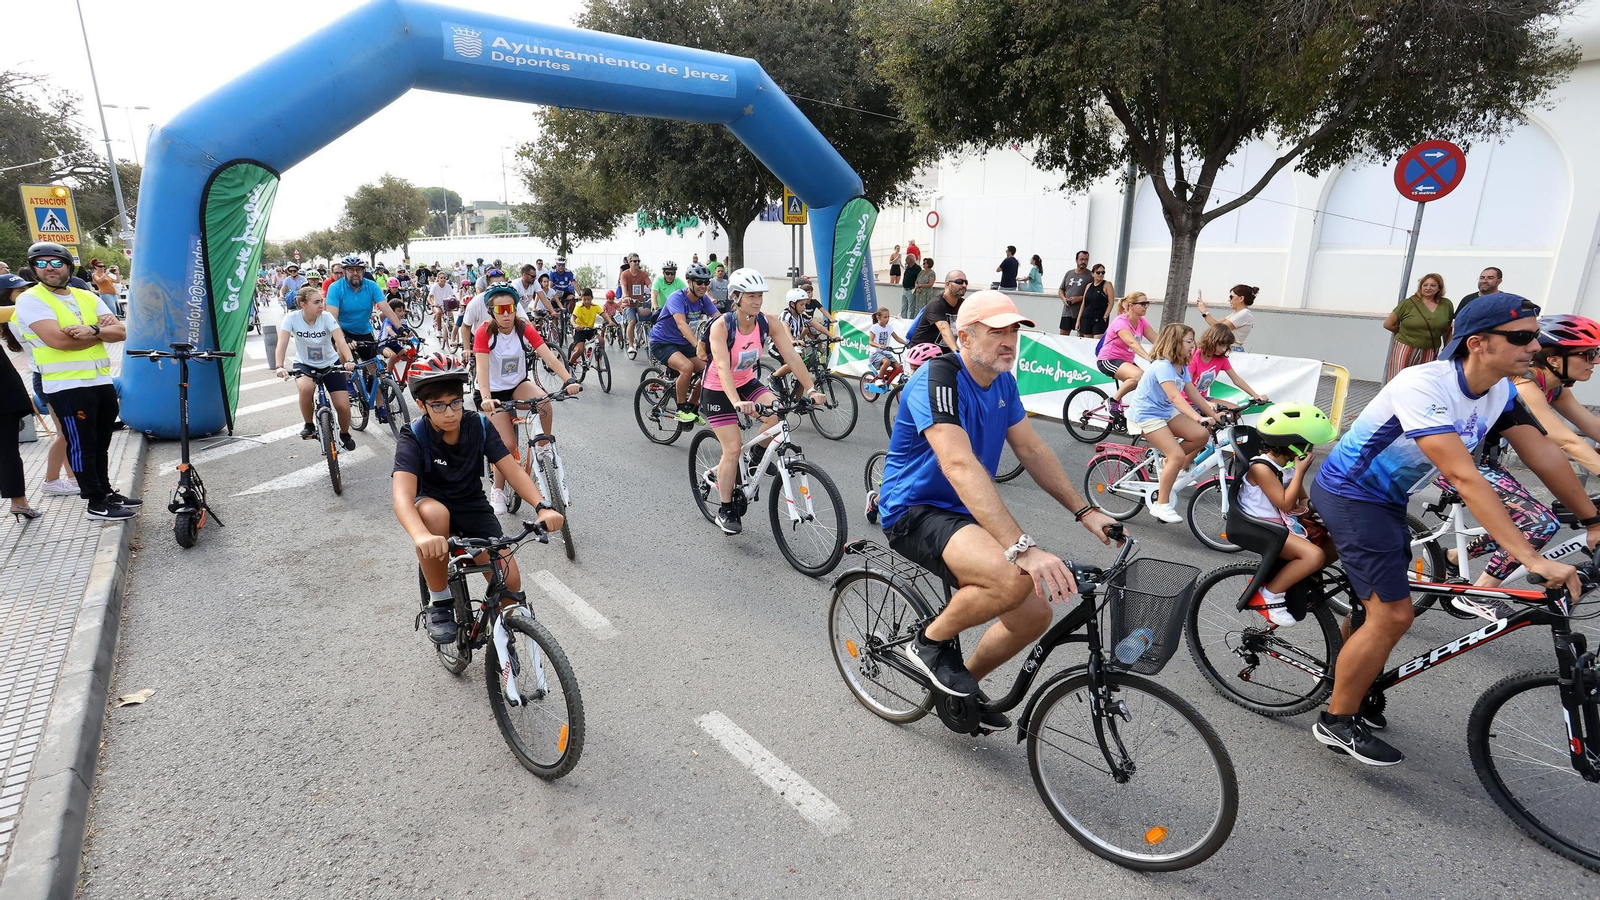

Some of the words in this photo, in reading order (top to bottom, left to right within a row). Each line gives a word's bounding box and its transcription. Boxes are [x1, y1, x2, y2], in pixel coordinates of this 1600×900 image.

[491, 36, 650, 71] Ayuntamiento
[656, 62, 678, 76] de
[683, 66, 730, 83] Jerez
[491, 50, 571, 71] Deportes
[29, 197, 67, 206] ATENCION
[37, 234, 75, 243] PEATONES
[222, 293, 240, 313] El
[296, 330, 327, 338] adidas
[1019, 358, 1030, 372] El
[1030, 360, 1054, 376] Corte
[1053, 360, 1092, 384] Inglés
